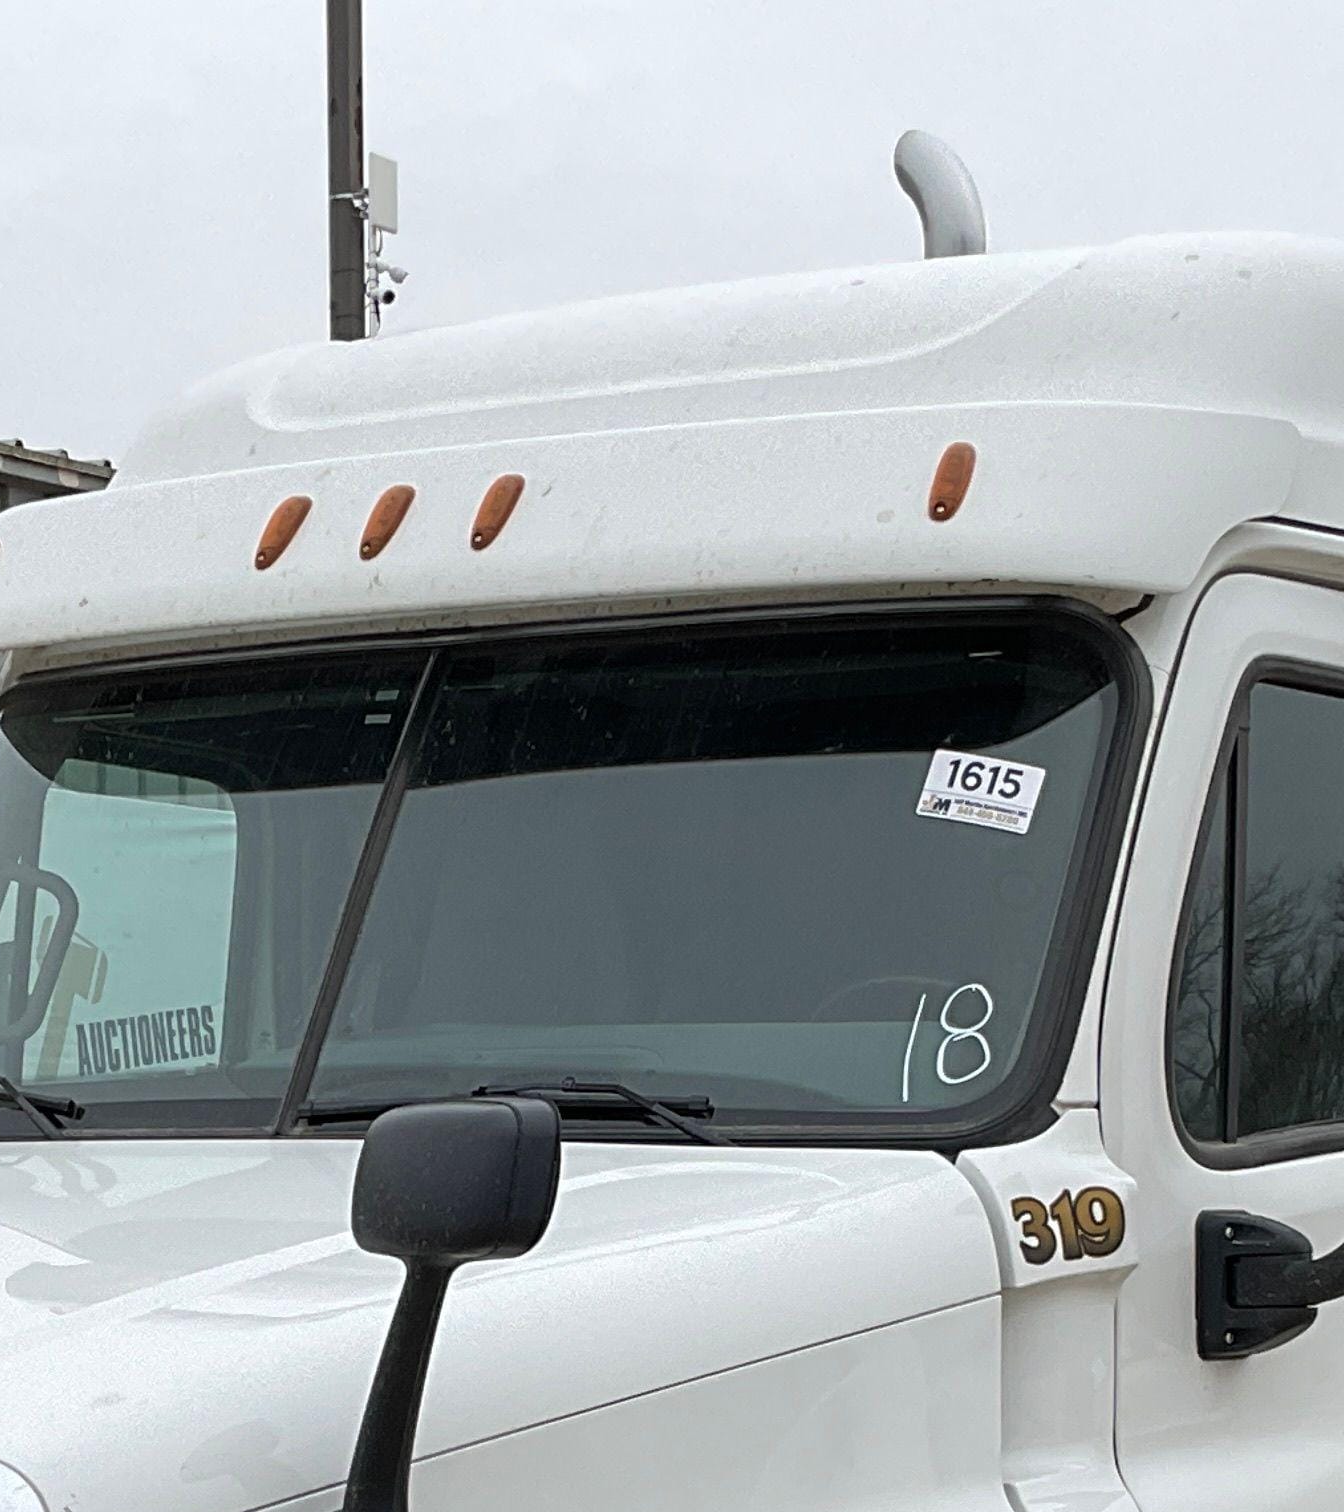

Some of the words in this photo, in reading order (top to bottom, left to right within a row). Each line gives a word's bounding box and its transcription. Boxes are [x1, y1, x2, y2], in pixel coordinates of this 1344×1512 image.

[947, 758, 1024, 799] 1615
[76, 1005, 216, 1076] AUCTIONEERS
[902, 983, 994, 1102] 18
[1010, 1186, 1126, 1265] 319
